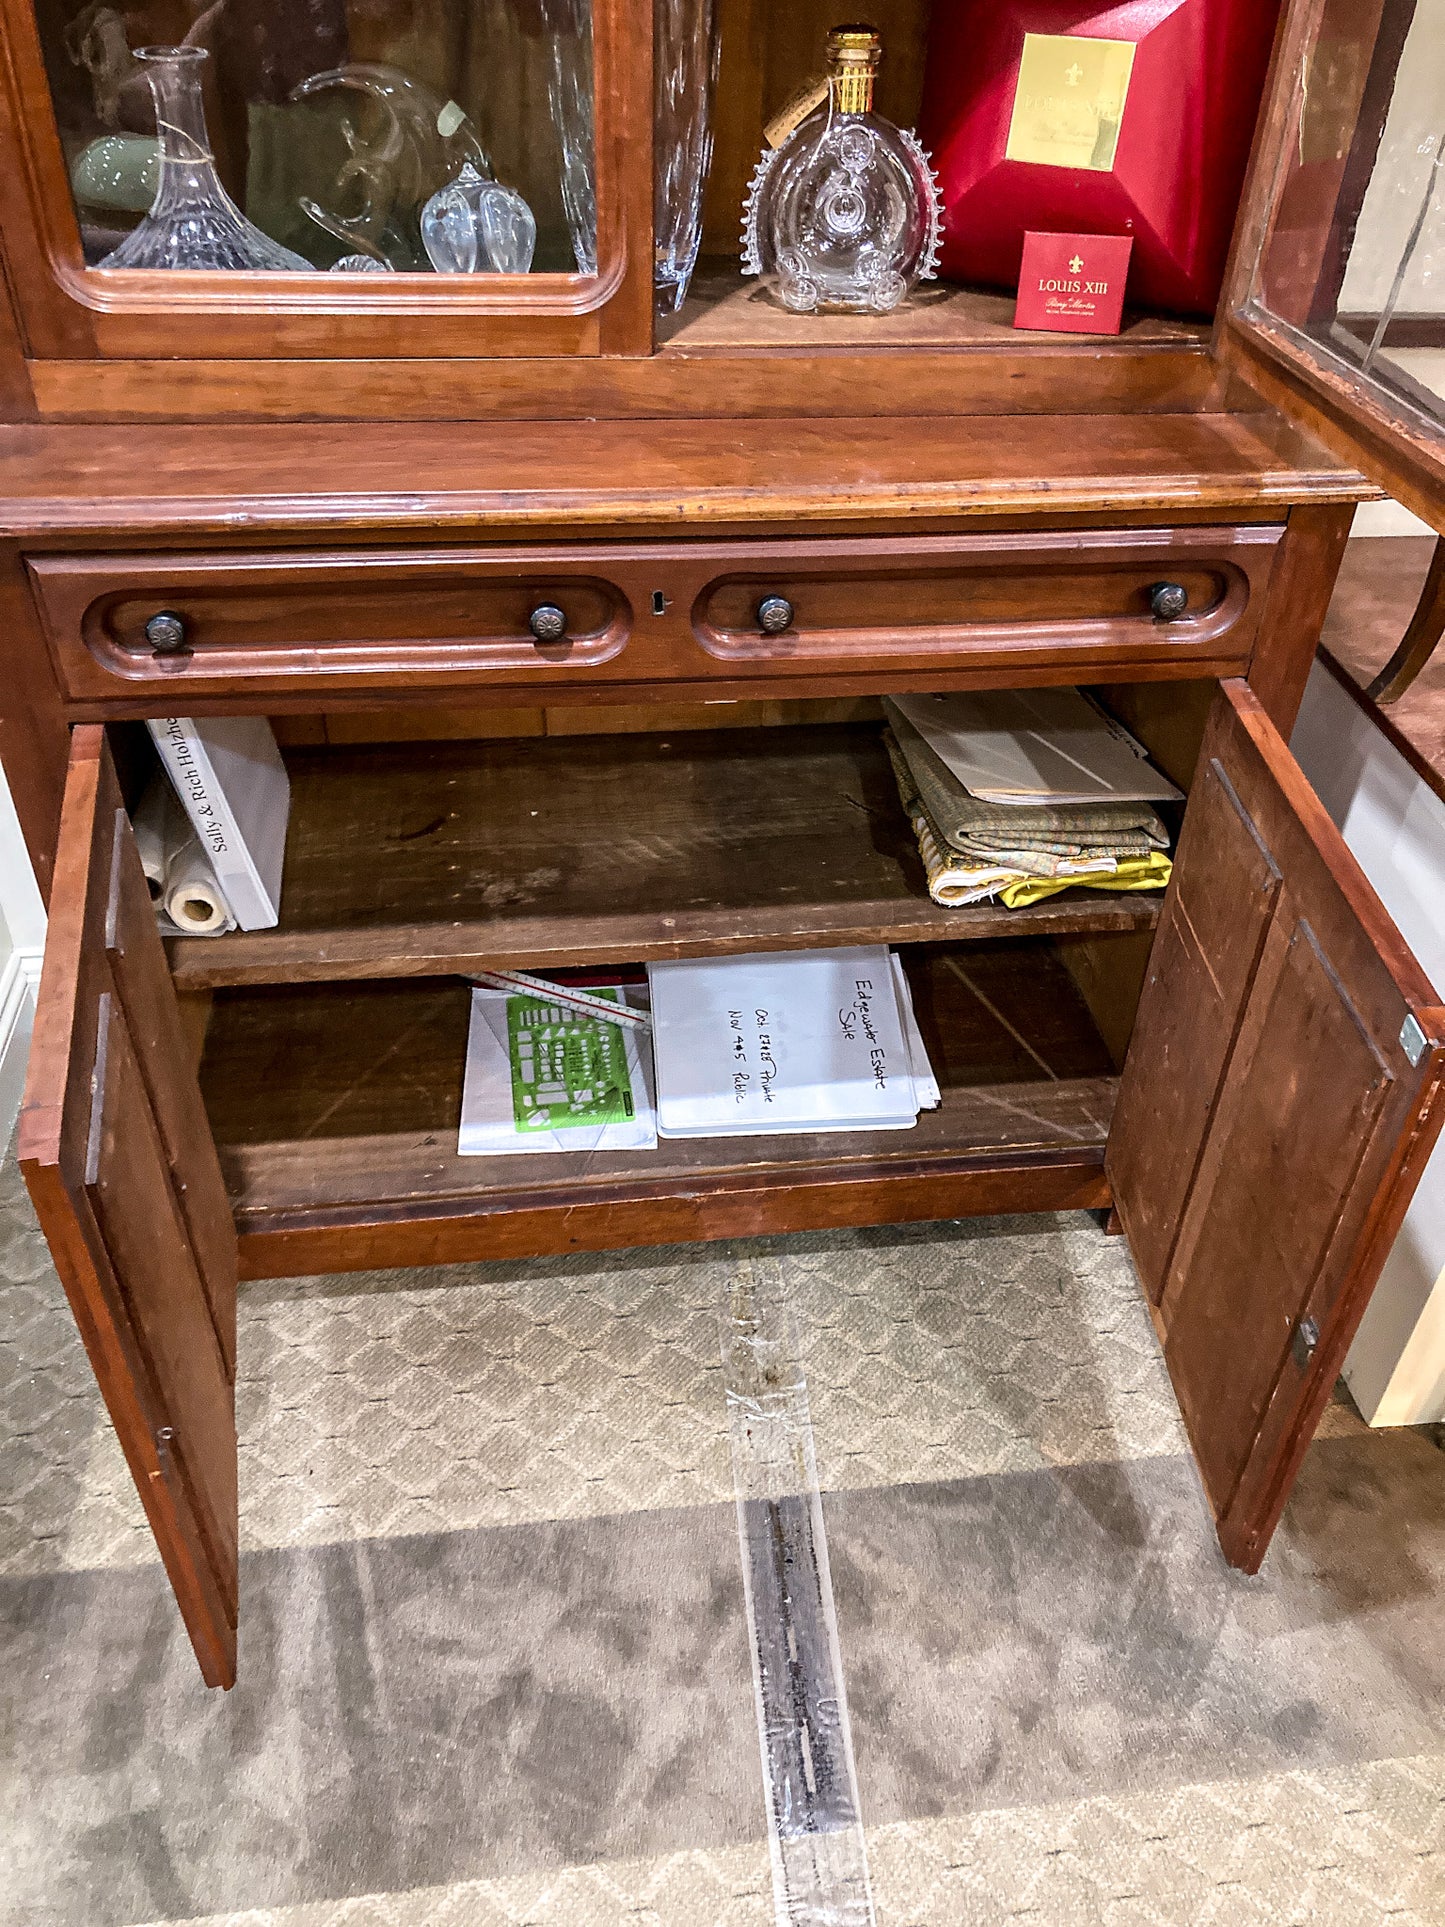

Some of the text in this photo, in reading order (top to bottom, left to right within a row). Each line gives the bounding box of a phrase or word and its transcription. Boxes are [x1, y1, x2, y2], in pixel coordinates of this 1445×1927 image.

[1038, 279, 1108, 295] LOUIS XIII
[184, 769, 207, 801] Rich
[198, 804, 213, 817] &
[205, 820, 228, 853] Sally
[728, 1010, 743, 1030] Nov
[839, 1008, 856, 1040] Sale
[870, 1048, 888, 1089] Estate
[731, 1072, 750, 1104] Public
[760, 1067, 777, 1103] Private
